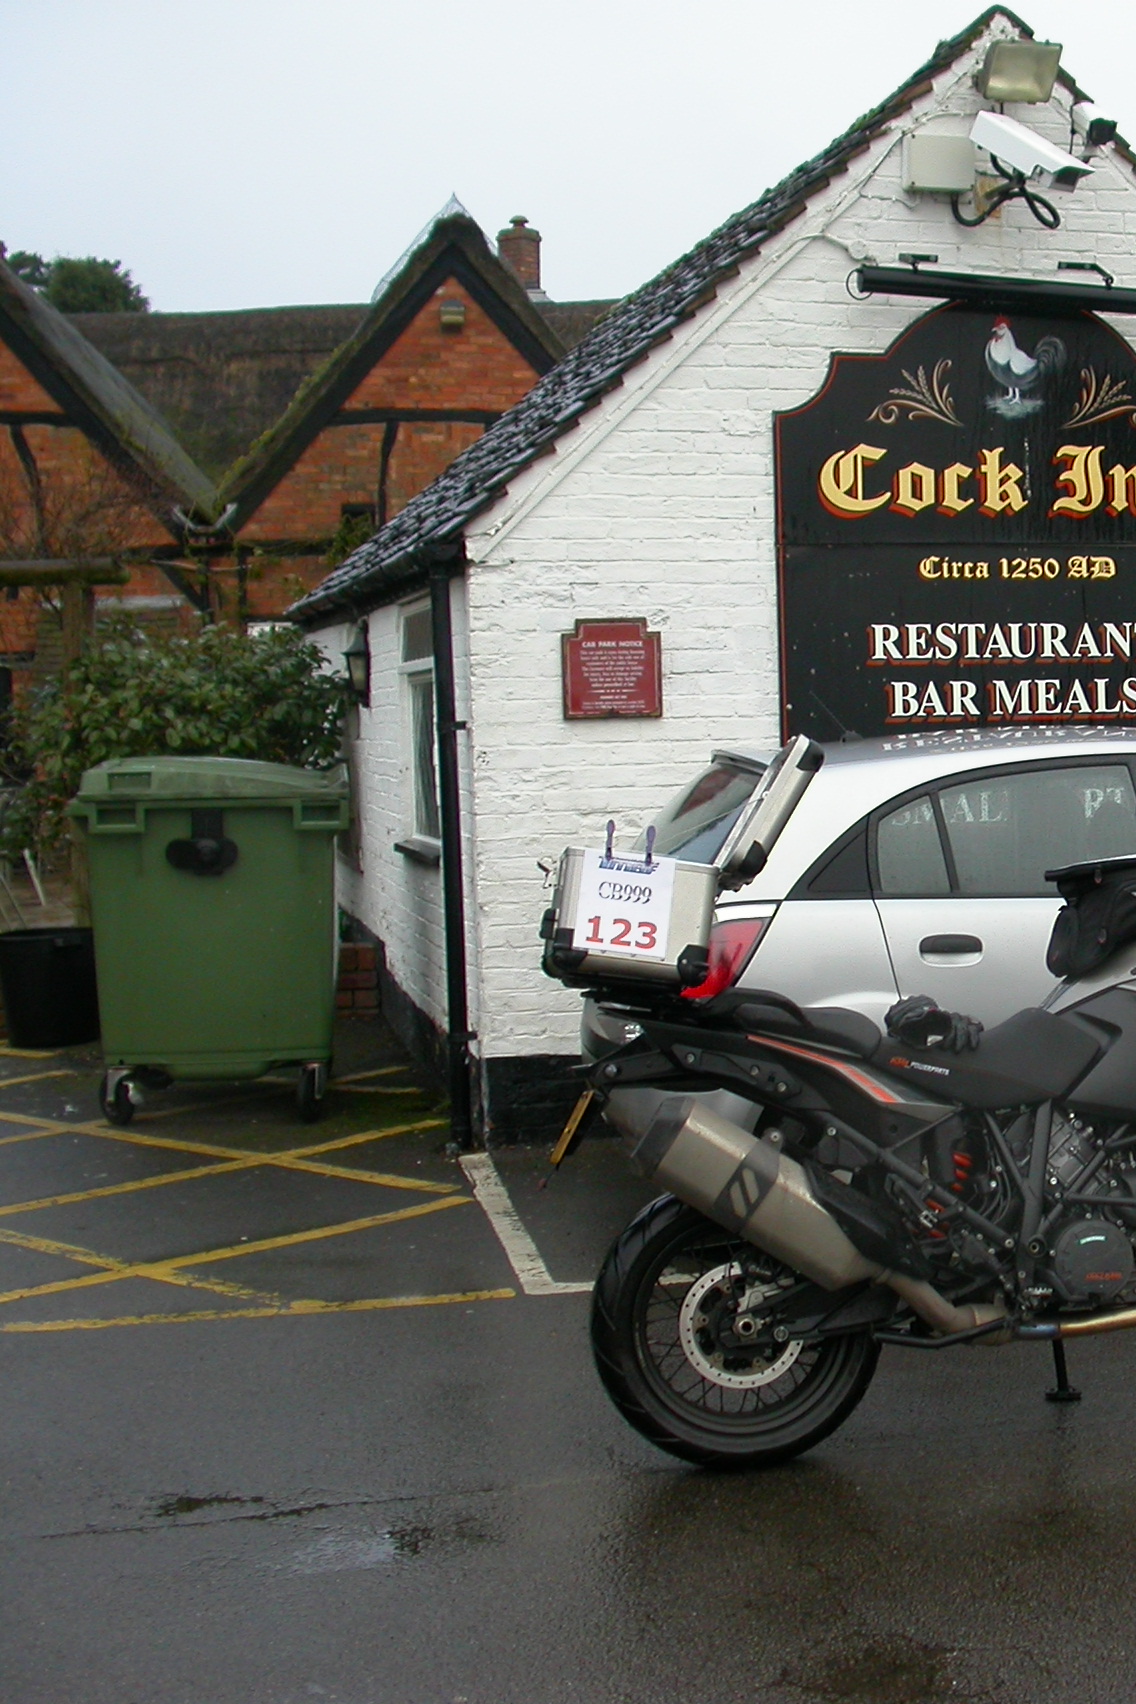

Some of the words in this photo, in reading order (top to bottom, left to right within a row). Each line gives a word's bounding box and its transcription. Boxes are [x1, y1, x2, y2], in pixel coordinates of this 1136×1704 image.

[818, 443, 1029, 518] Cock
[919, 555, 990, 580] Circa
[998, 556, 1060, 580] 1250
[1067, 555, 1117, 580] AD
[884, 680, 982, 723] BAR
[598, 880, 653, 905] CB999
[585, 915, 658, 950] 123
